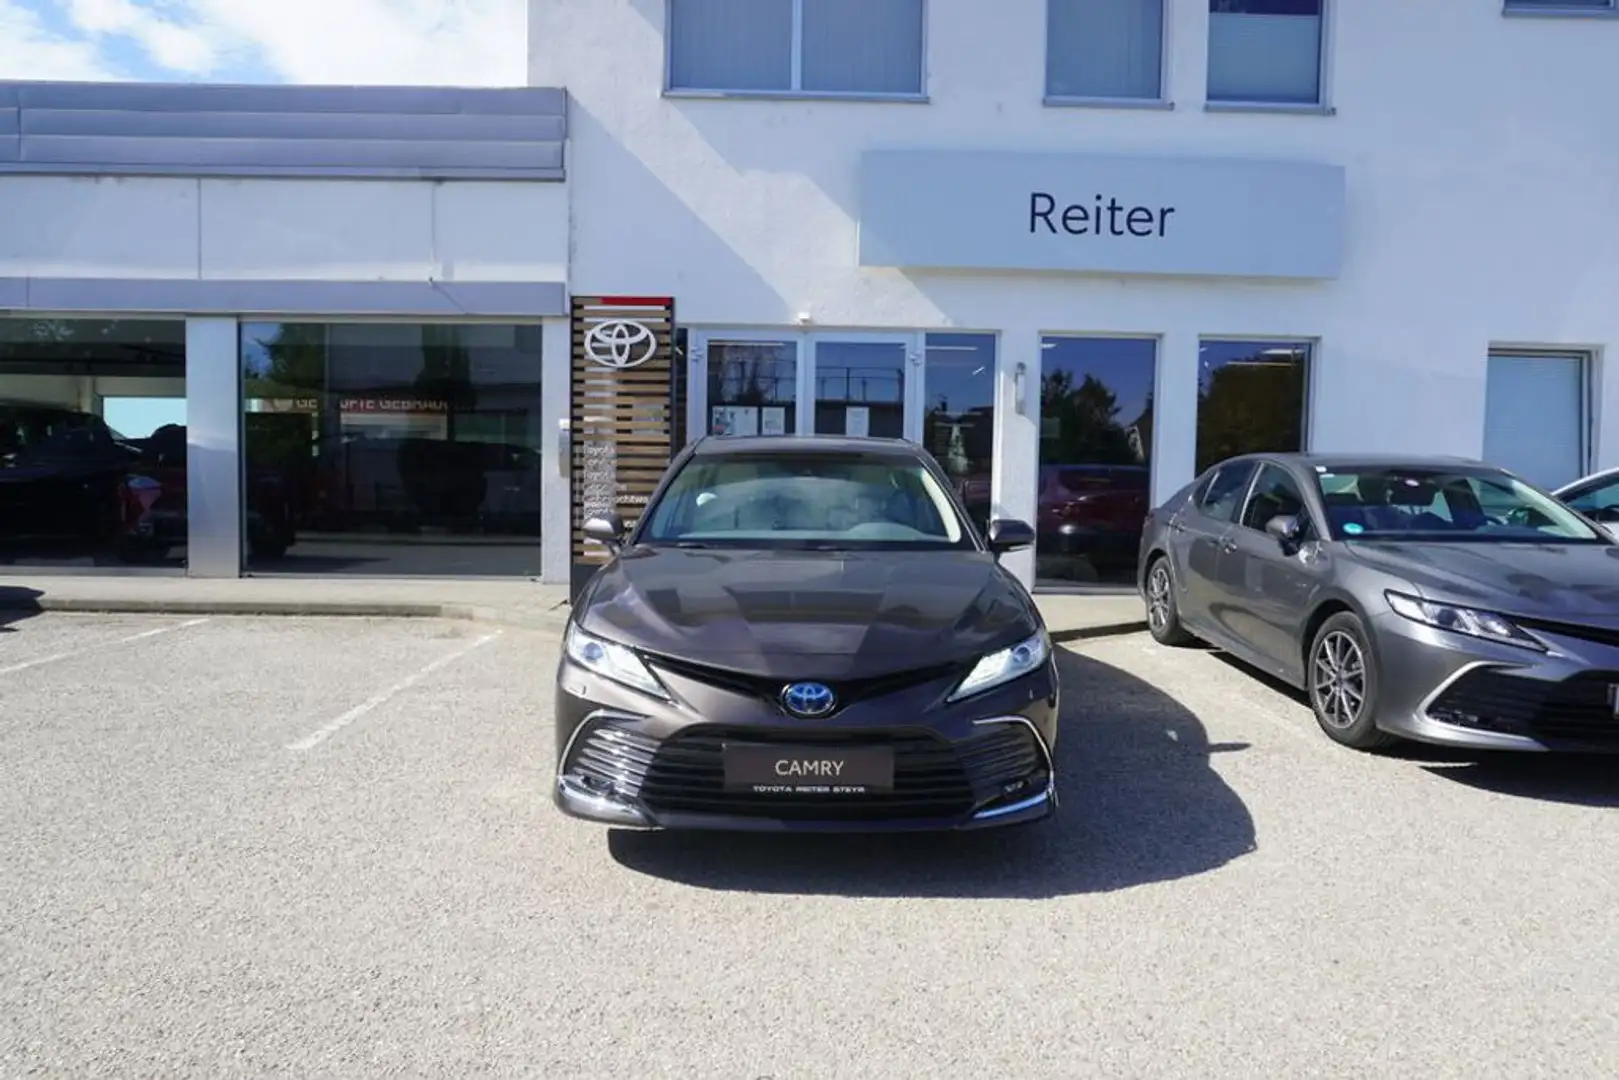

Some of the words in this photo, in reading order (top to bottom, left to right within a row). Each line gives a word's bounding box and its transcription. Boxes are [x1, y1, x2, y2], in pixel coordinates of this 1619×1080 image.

[1029, 192, 1175, 237] Reiter
[774, 759, 844, 777] CAMRY
[752, 785, 792, 793] TOYOTA
